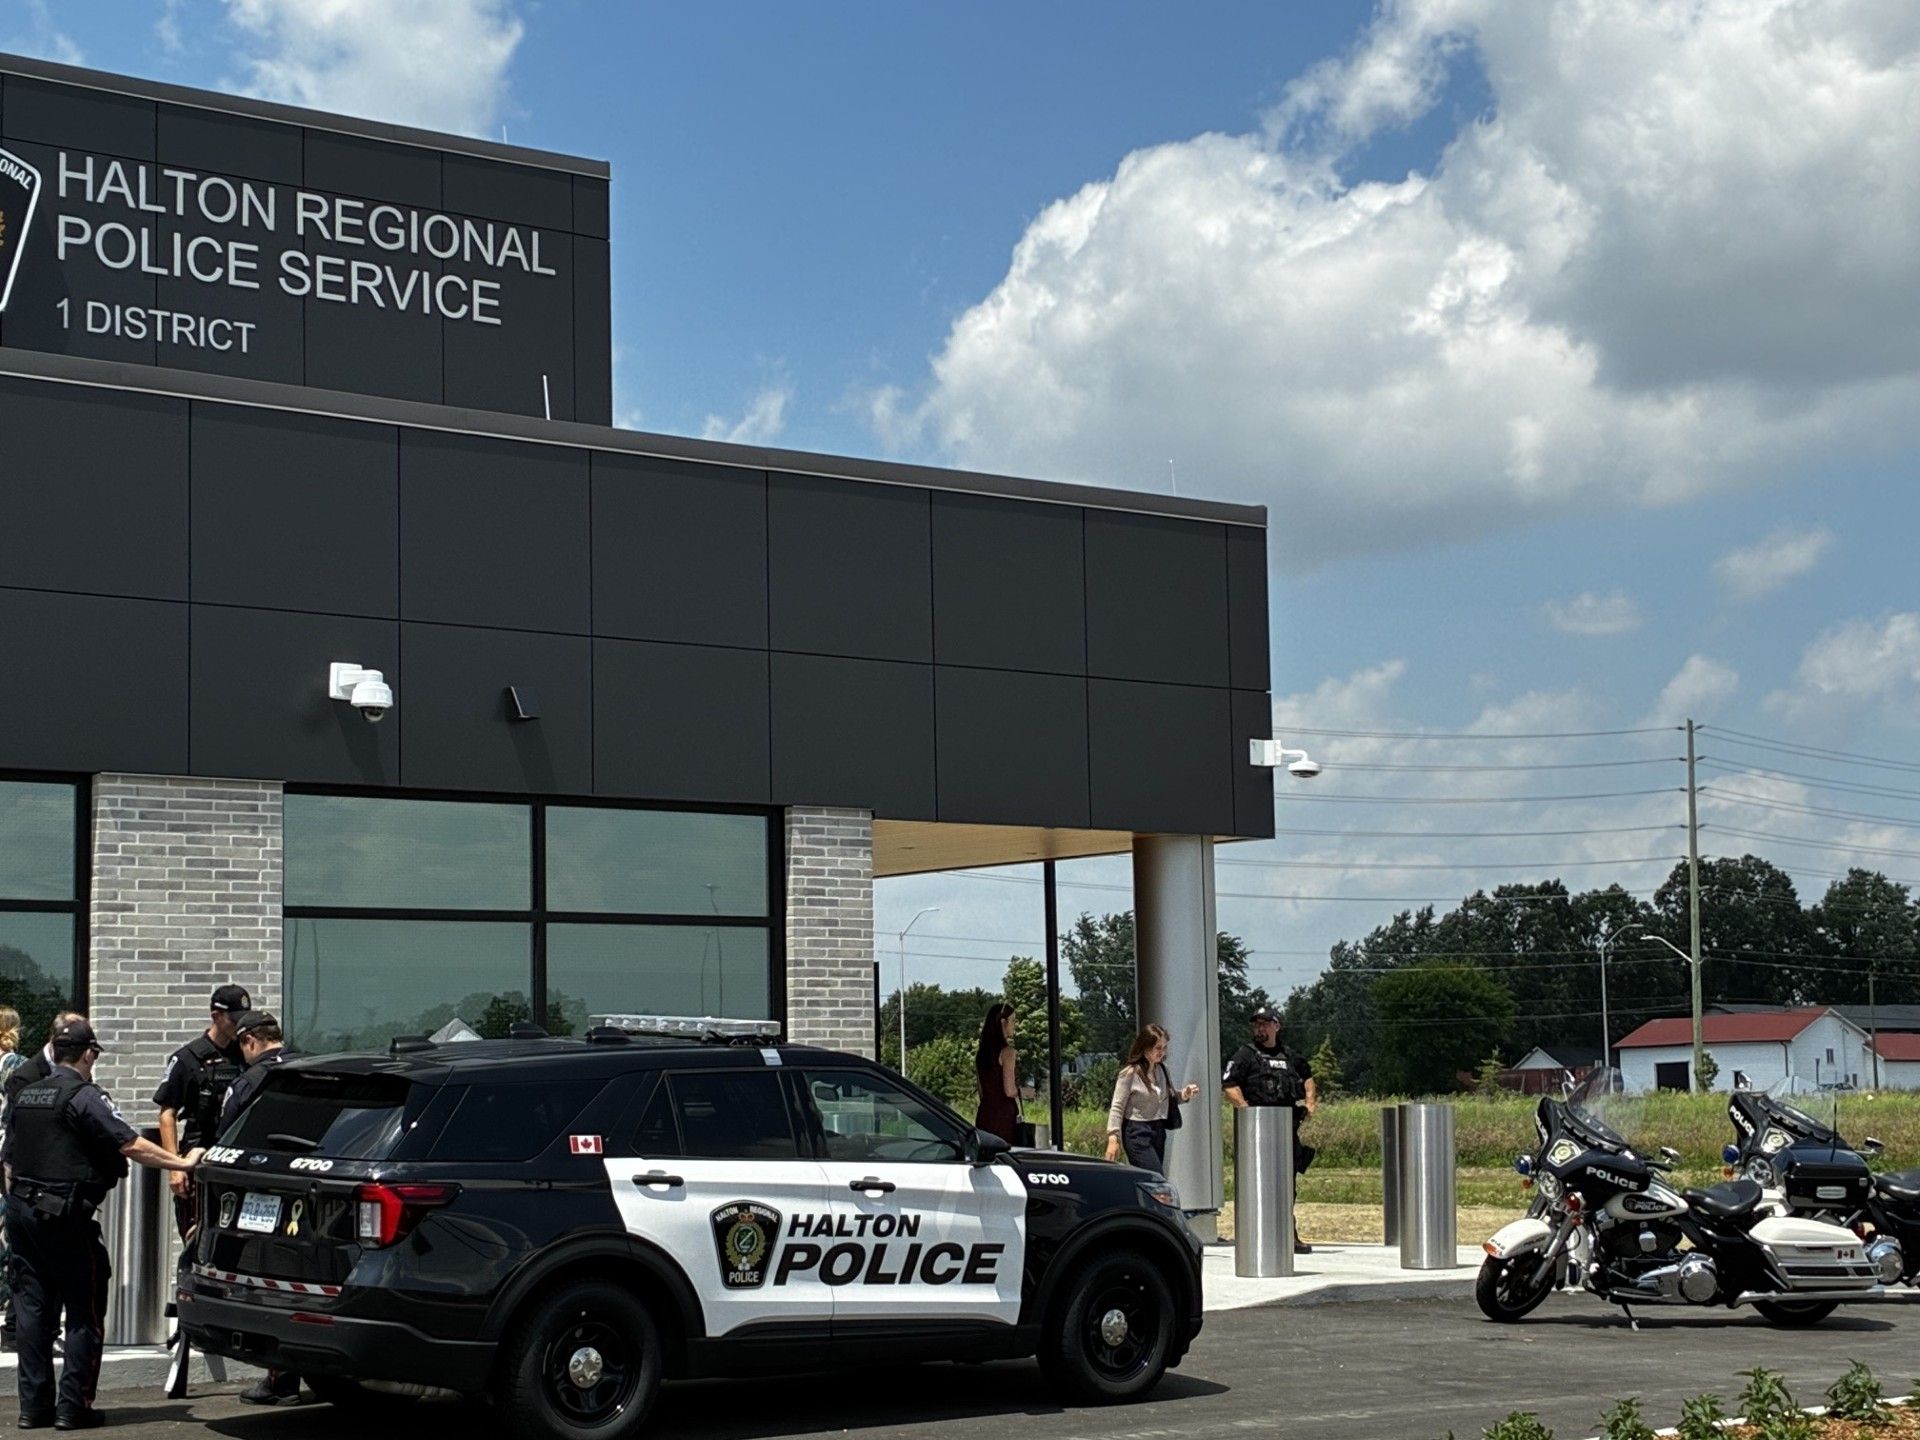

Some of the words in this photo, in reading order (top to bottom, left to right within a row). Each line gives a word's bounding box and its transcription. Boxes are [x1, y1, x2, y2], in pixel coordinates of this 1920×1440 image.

[58, 151, 275, 231] HALTON
[296, 190, 557, 276] REGIONAL
[57, 214, 260, 290] POLICE
[278, 249, 502, 325] SERVICE
[56, 298, 70, 329] 1
[86, 301, 256, 353] DISTRICT
[18, 1095, 55, 1105] POLICE
[289, 1158, 334, 1171] 6700
[1028, 1173, 1070, 1184] 6700
[1586, 1166, 1639, 1190] POLICE
[715, 1206, 739, 1222] HALTON
[749, 1205, 778, 1223] REGIONAL
[787, 1214, 921, 1238] HALTON
[773, 1242, 1004, 1287] POLICE
[728, 1271, 759, 1283] POLICE
